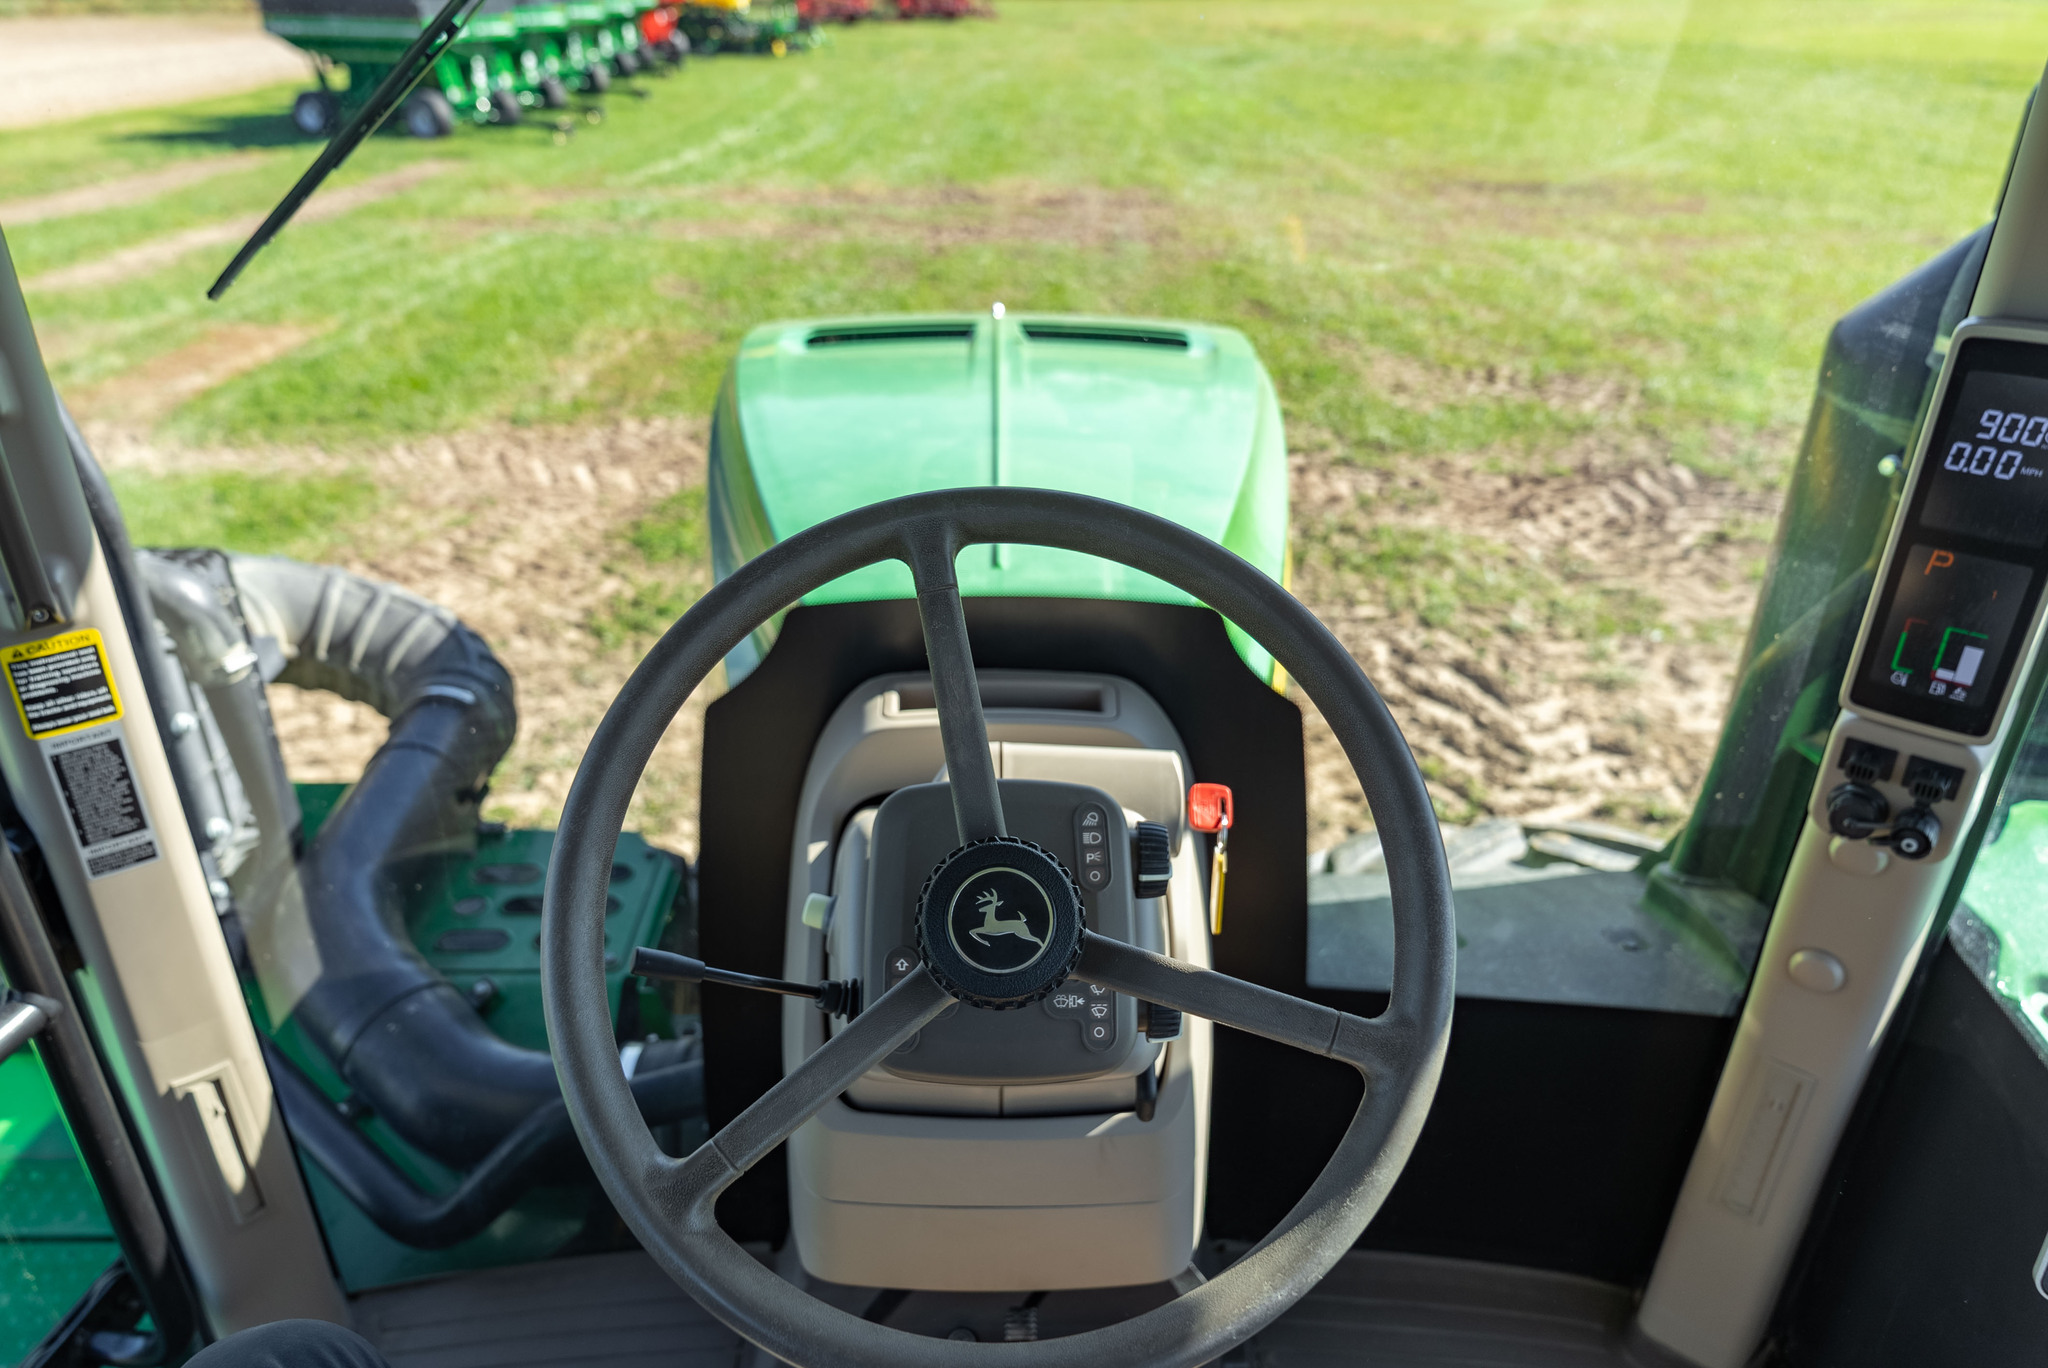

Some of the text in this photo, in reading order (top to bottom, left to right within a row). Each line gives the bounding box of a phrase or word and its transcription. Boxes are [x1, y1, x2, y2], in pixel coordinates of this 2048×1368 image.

[1944, 441, 2043, 480] 0.00 MPH
[1924, 550, 1954, 575] P
